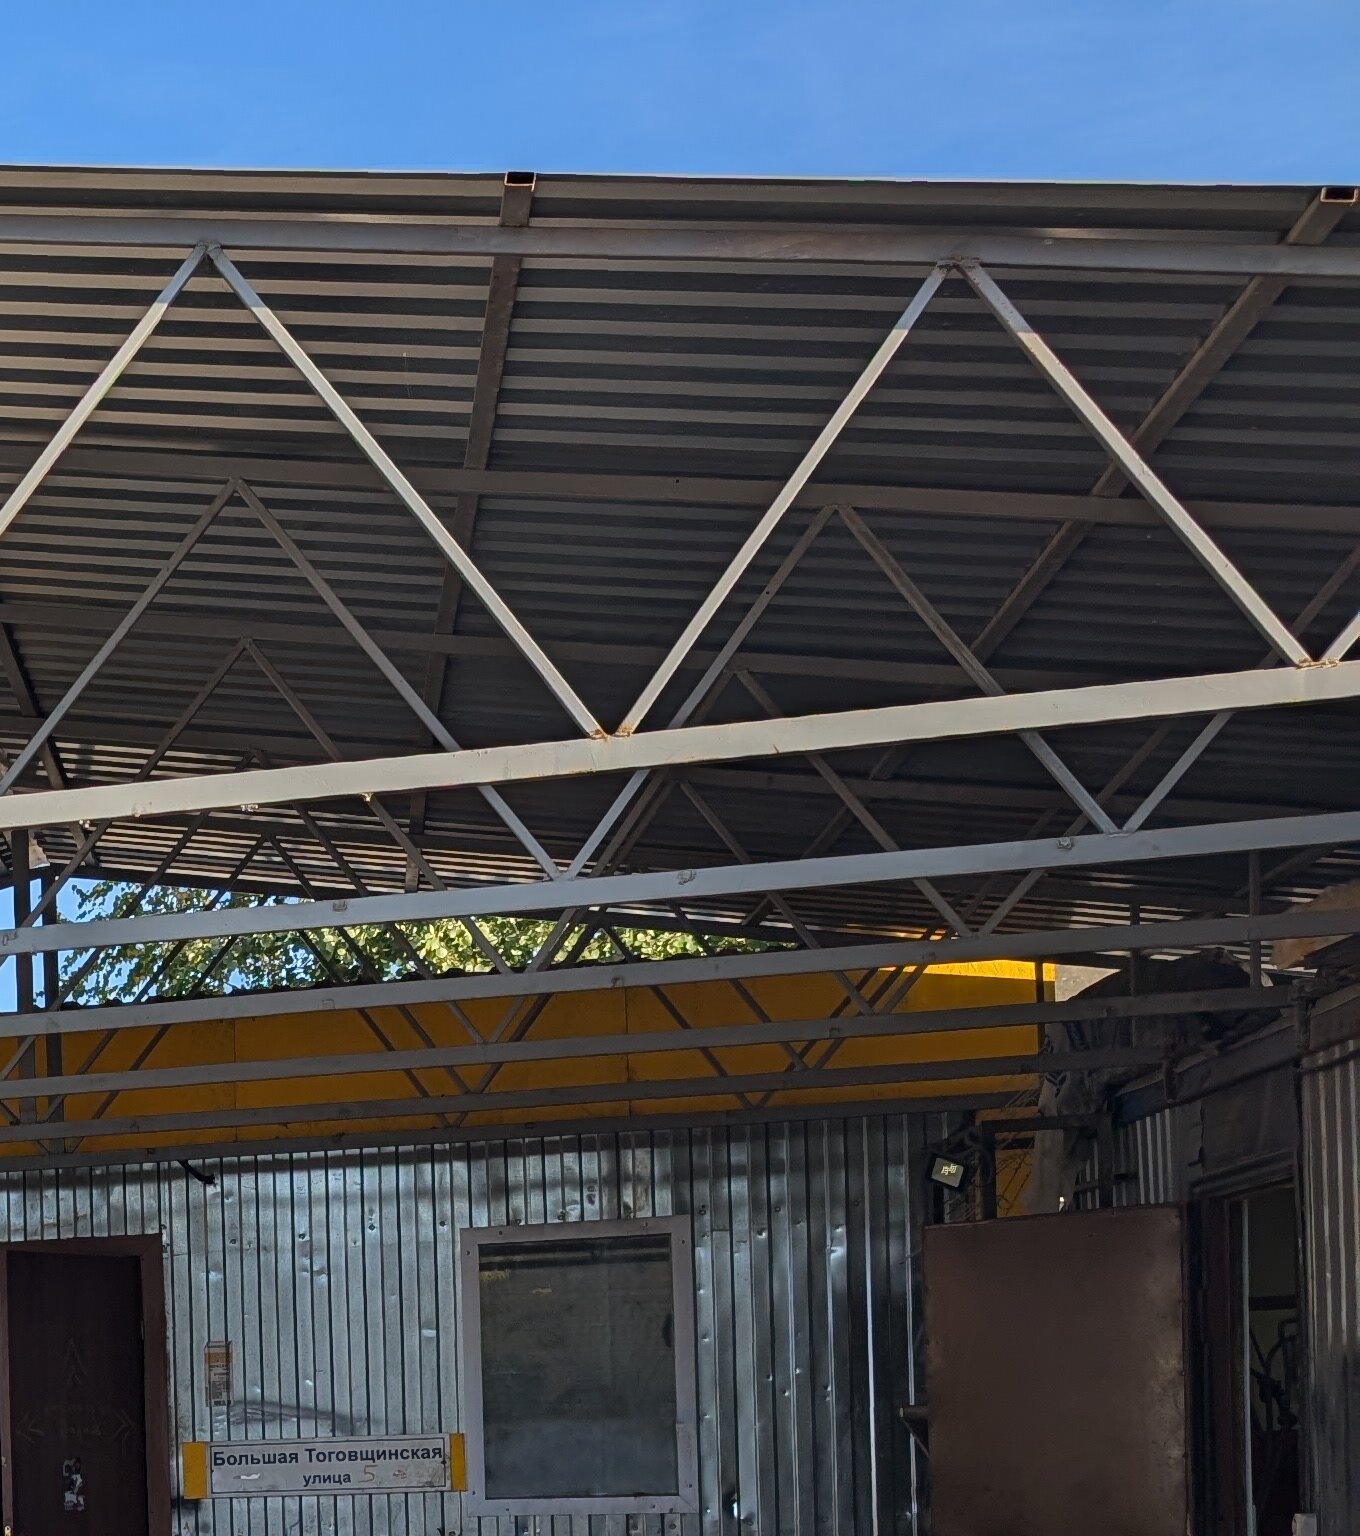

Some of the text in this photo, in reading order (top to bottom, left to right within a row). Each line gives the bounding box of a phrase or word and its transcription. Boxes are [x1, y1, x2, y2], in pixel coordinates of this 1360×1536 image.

[213, 1447, 443, 1467] Большая Тоговщинская
[302, 1472, 352, 1487] улица
